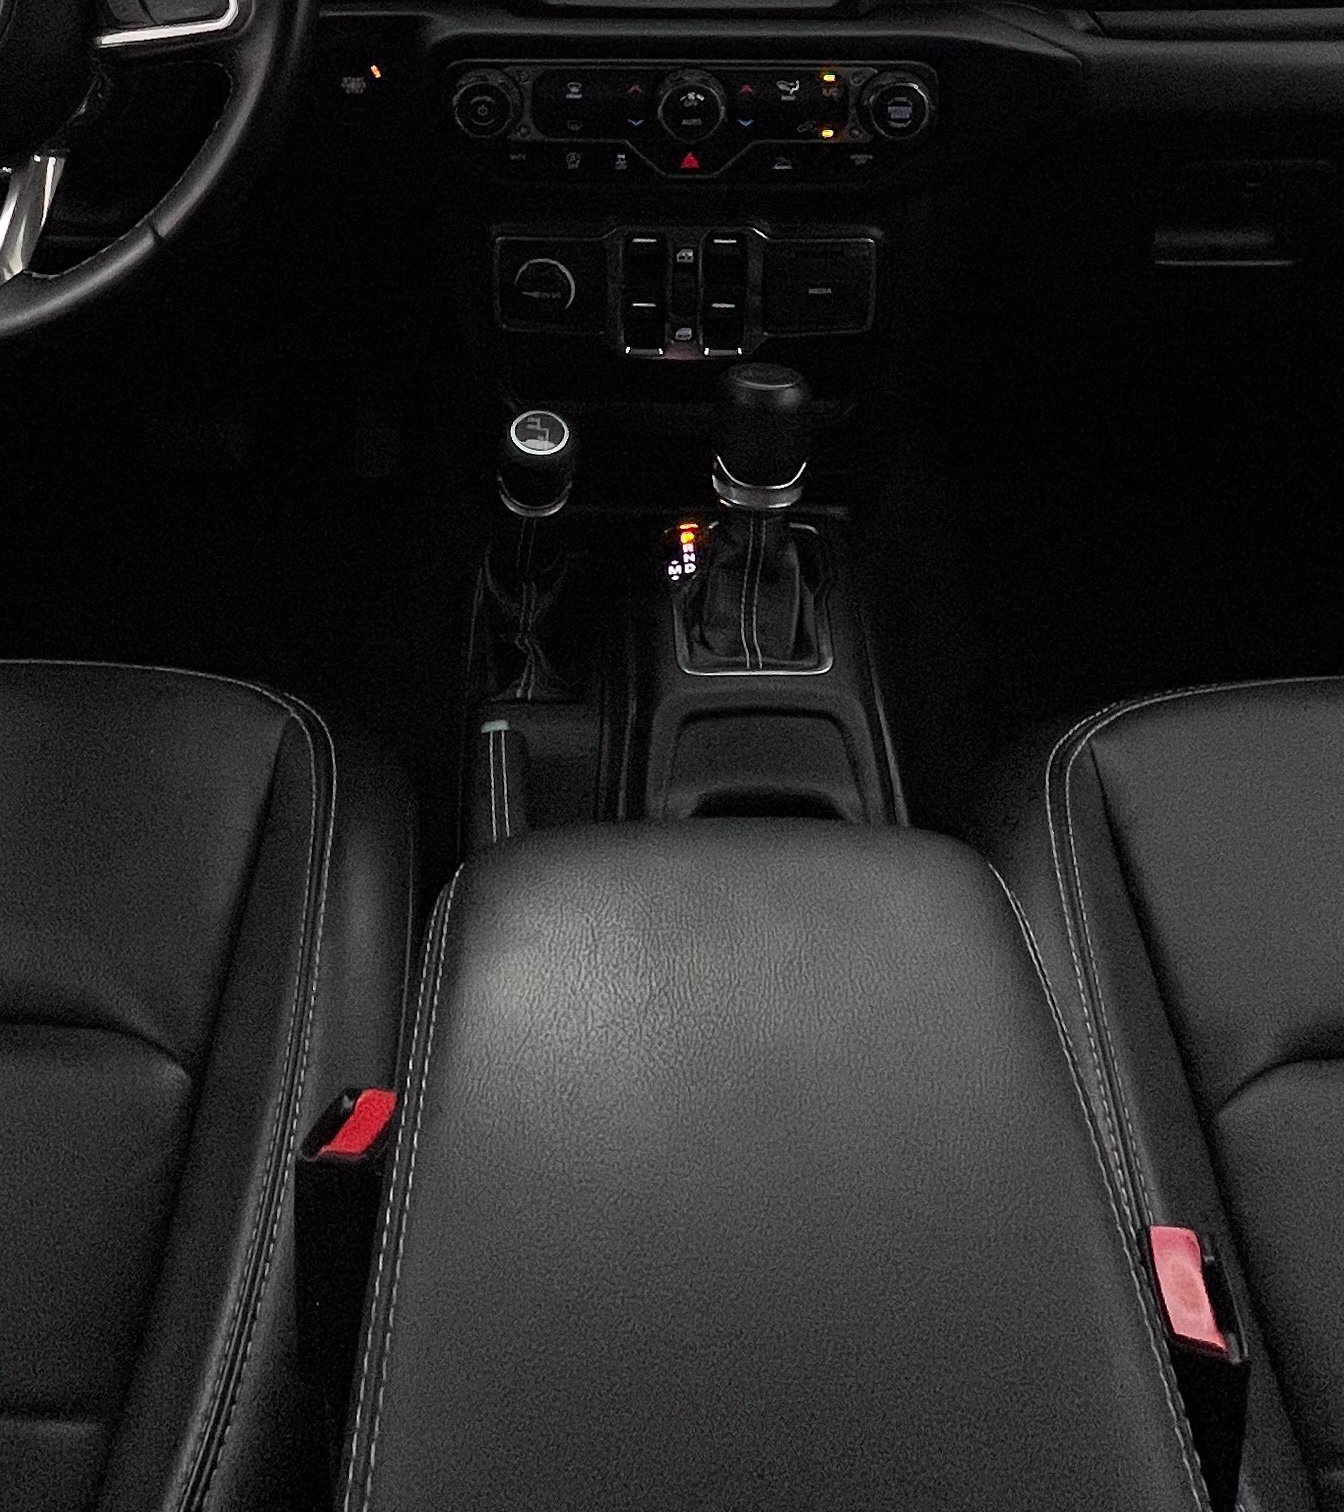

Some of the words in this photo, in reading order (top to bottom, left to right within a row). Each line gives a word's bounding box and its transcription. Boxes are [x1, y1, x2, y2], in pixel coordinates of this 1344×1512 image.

[683, 552, 696, 563] N
[668, 564, 683, 576] M
[684, 562, 697, 574] D
